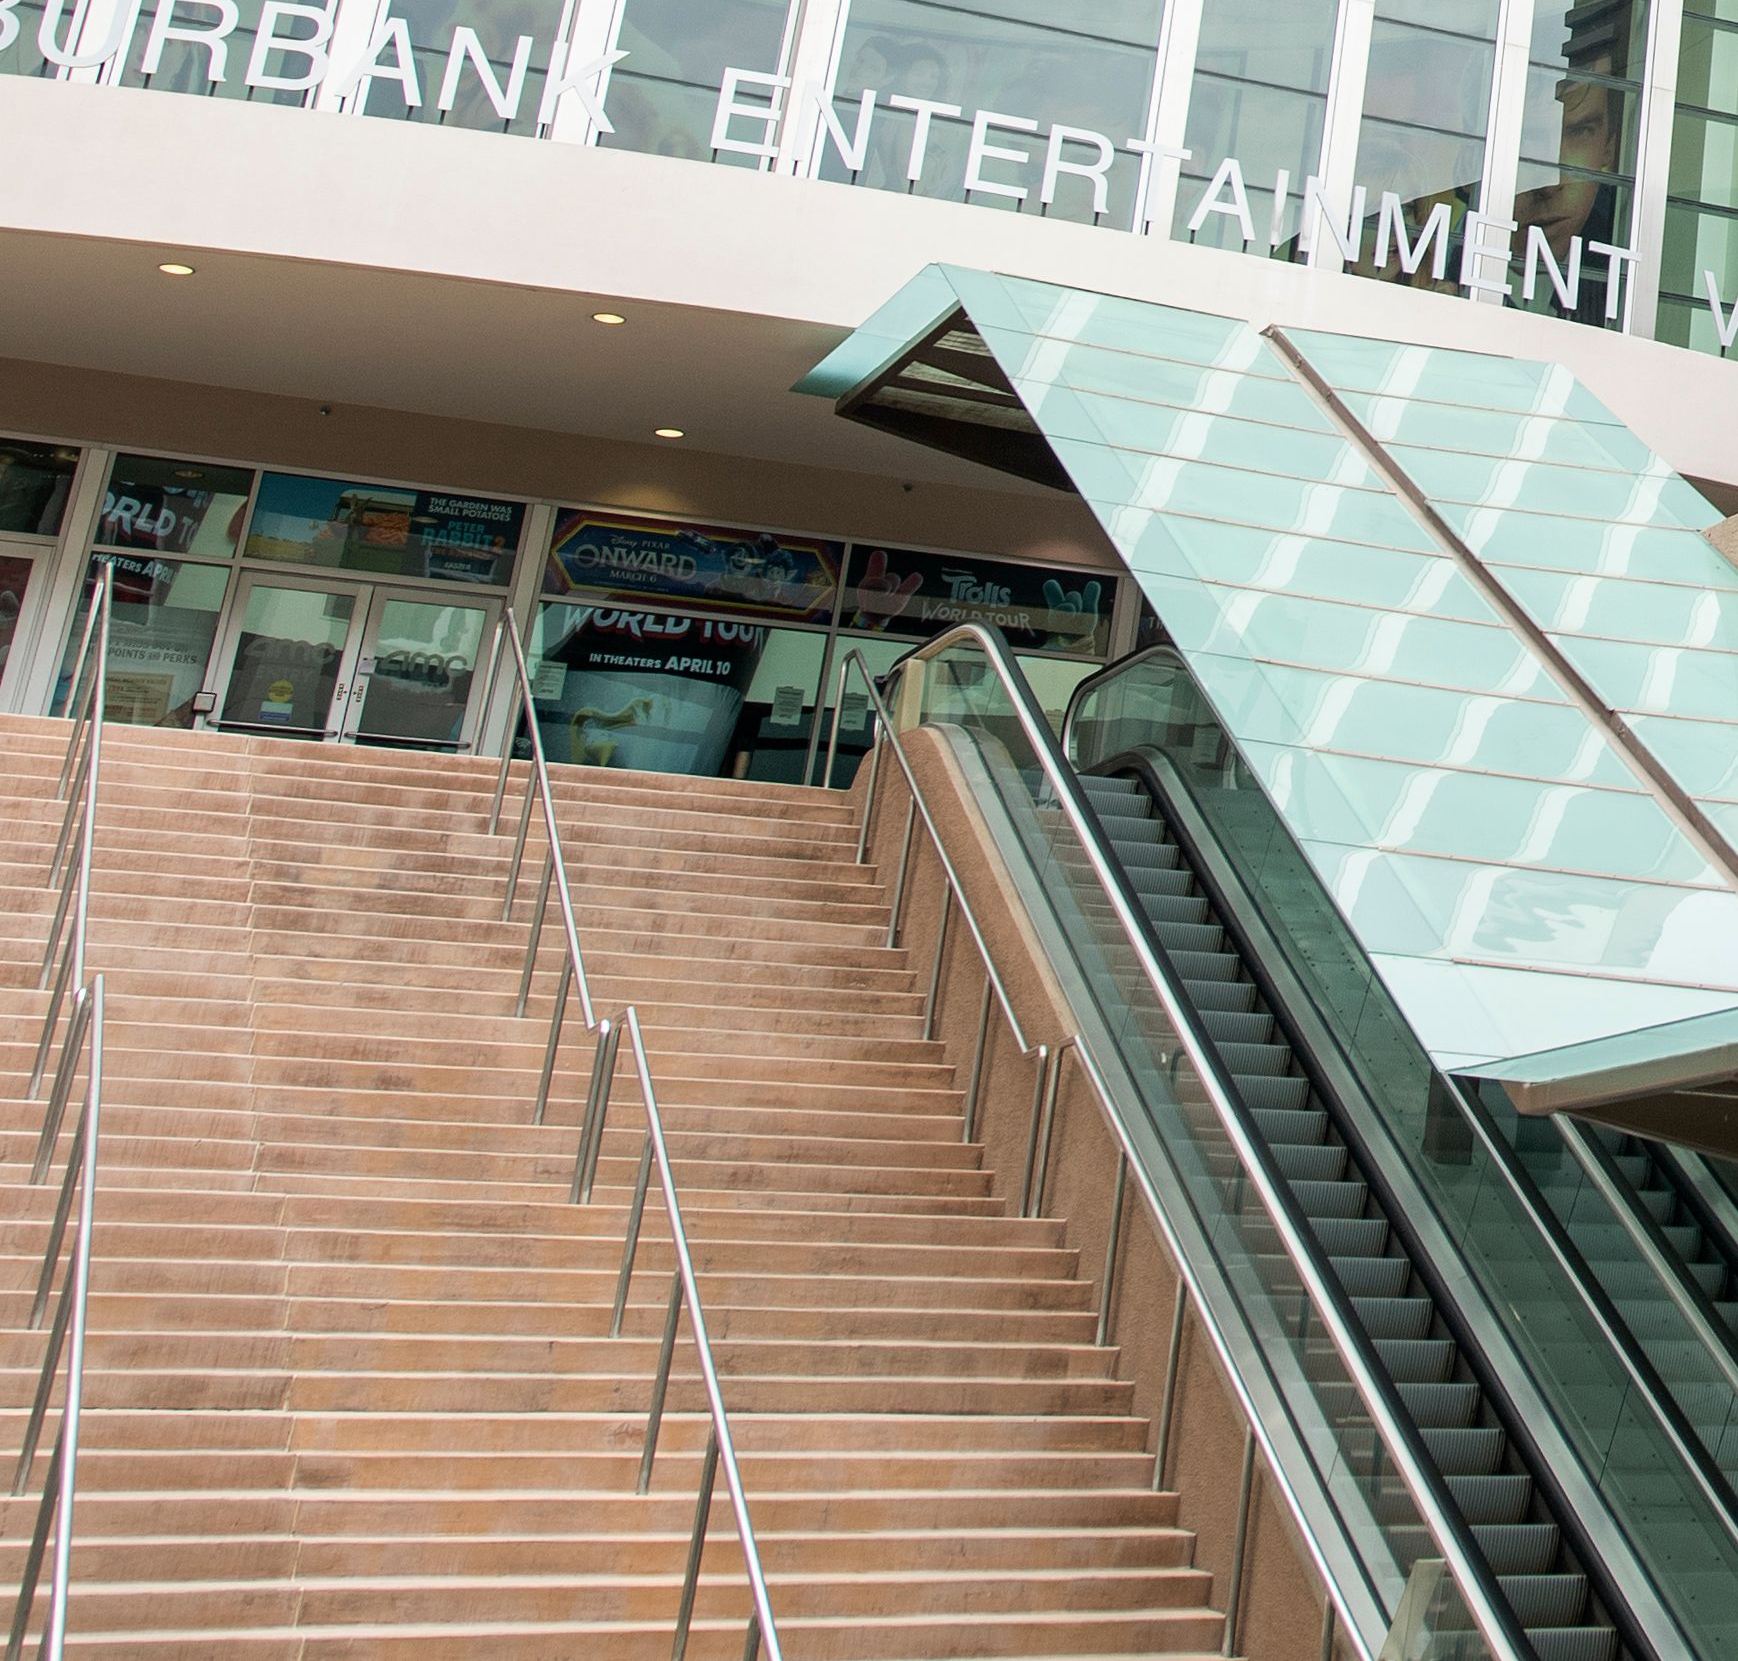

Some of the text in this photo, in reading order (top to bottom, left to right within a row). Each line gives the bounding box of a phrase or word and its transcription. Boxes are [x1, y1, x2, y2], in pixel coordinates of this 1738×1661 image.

[710, 65, 1642, 322] ENTERTAINMENT
[428, 505, 511, 521] SMALL POTATOES
[430, 498, 512, 514] THE GARDEN WAS
[448, 520, 486, 533] PETER
[421, 527, 493, 550] RABBIT
[641, 540, 670, 550] PIXAR
[575, 544, 697, 584] ONWARD
[609, 570, 657, 583] MARCH 6
[986, 612, 1036, 637] TOUR
[109, 647, 145, 660] POINTS
[163, 652, 198, 665] PERKS
[381, 650, 467, 678] amc
[589, 653, 731, 675] IN THEATERS APRIL 10
